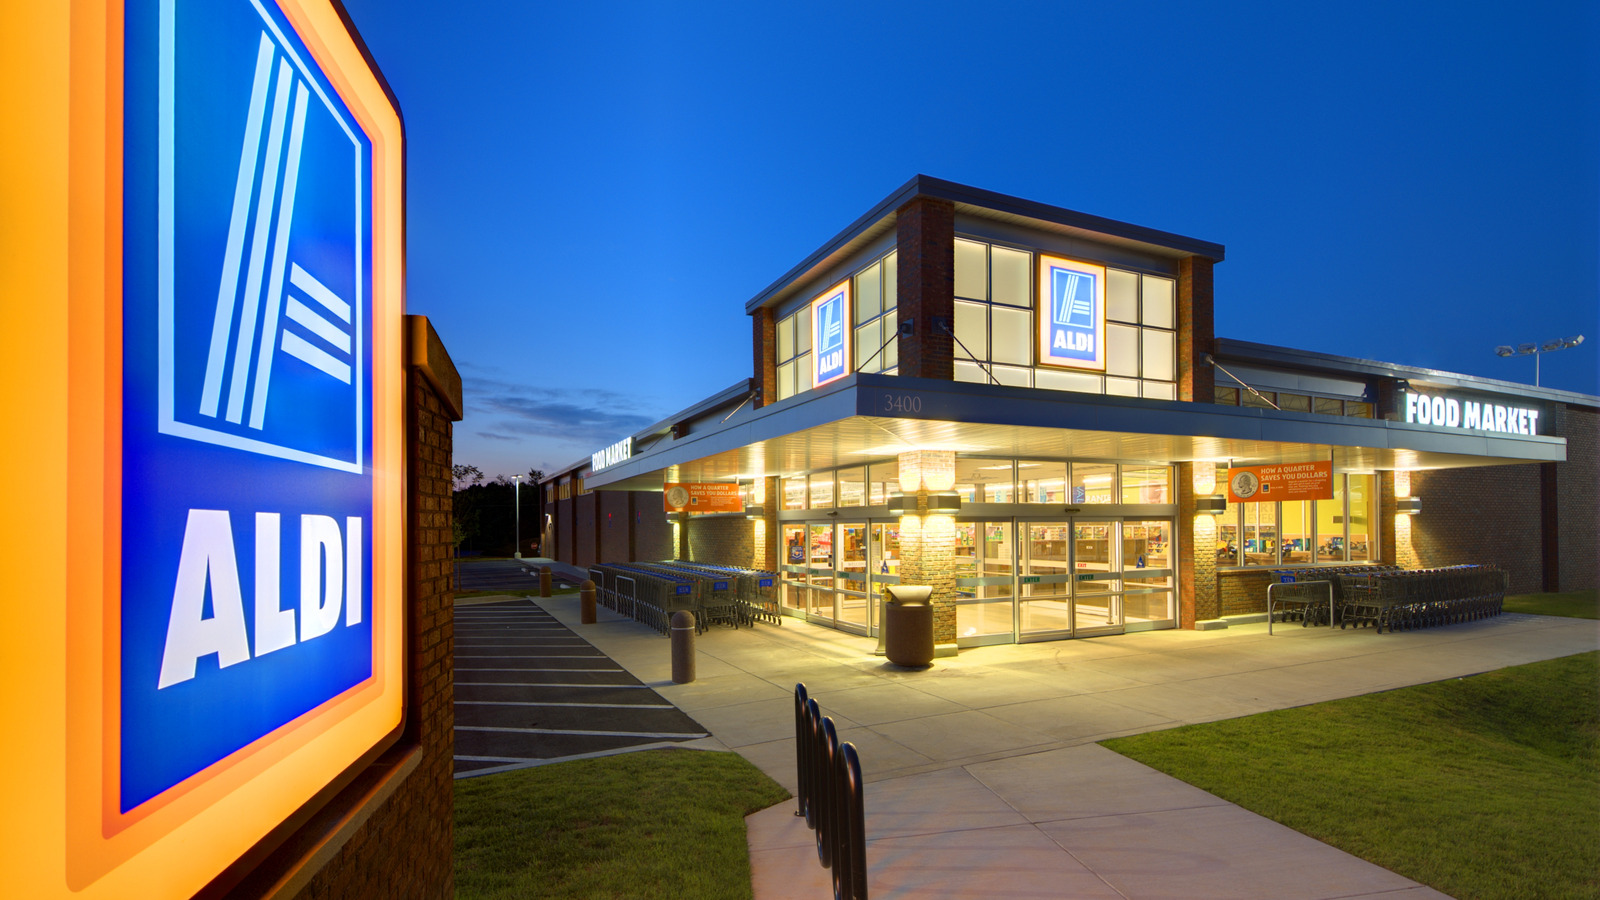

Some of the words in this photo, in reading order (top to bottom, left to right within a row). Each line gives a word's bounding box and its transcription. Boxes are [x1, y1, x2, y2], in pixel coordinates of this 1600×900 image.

[1053, 329, 1094, 353] ALDI
[819, 349, 843, 376] ALDI
[884, 394, 922, 413] 3400
[1406, 393, 1460, 428] FOOD
[1463, 400, 1539, 436] MARKET
[592, 449, 606, 472] FOOD
[605, 436, 632, 467] MARKET
[1260, 474, 1281, 482] SAVES
[1296, 471, 1328, 479] DOLLARS
[1283, 464, 1315, 474] QUARTER
[157, 508, 363, 690] ALDI
